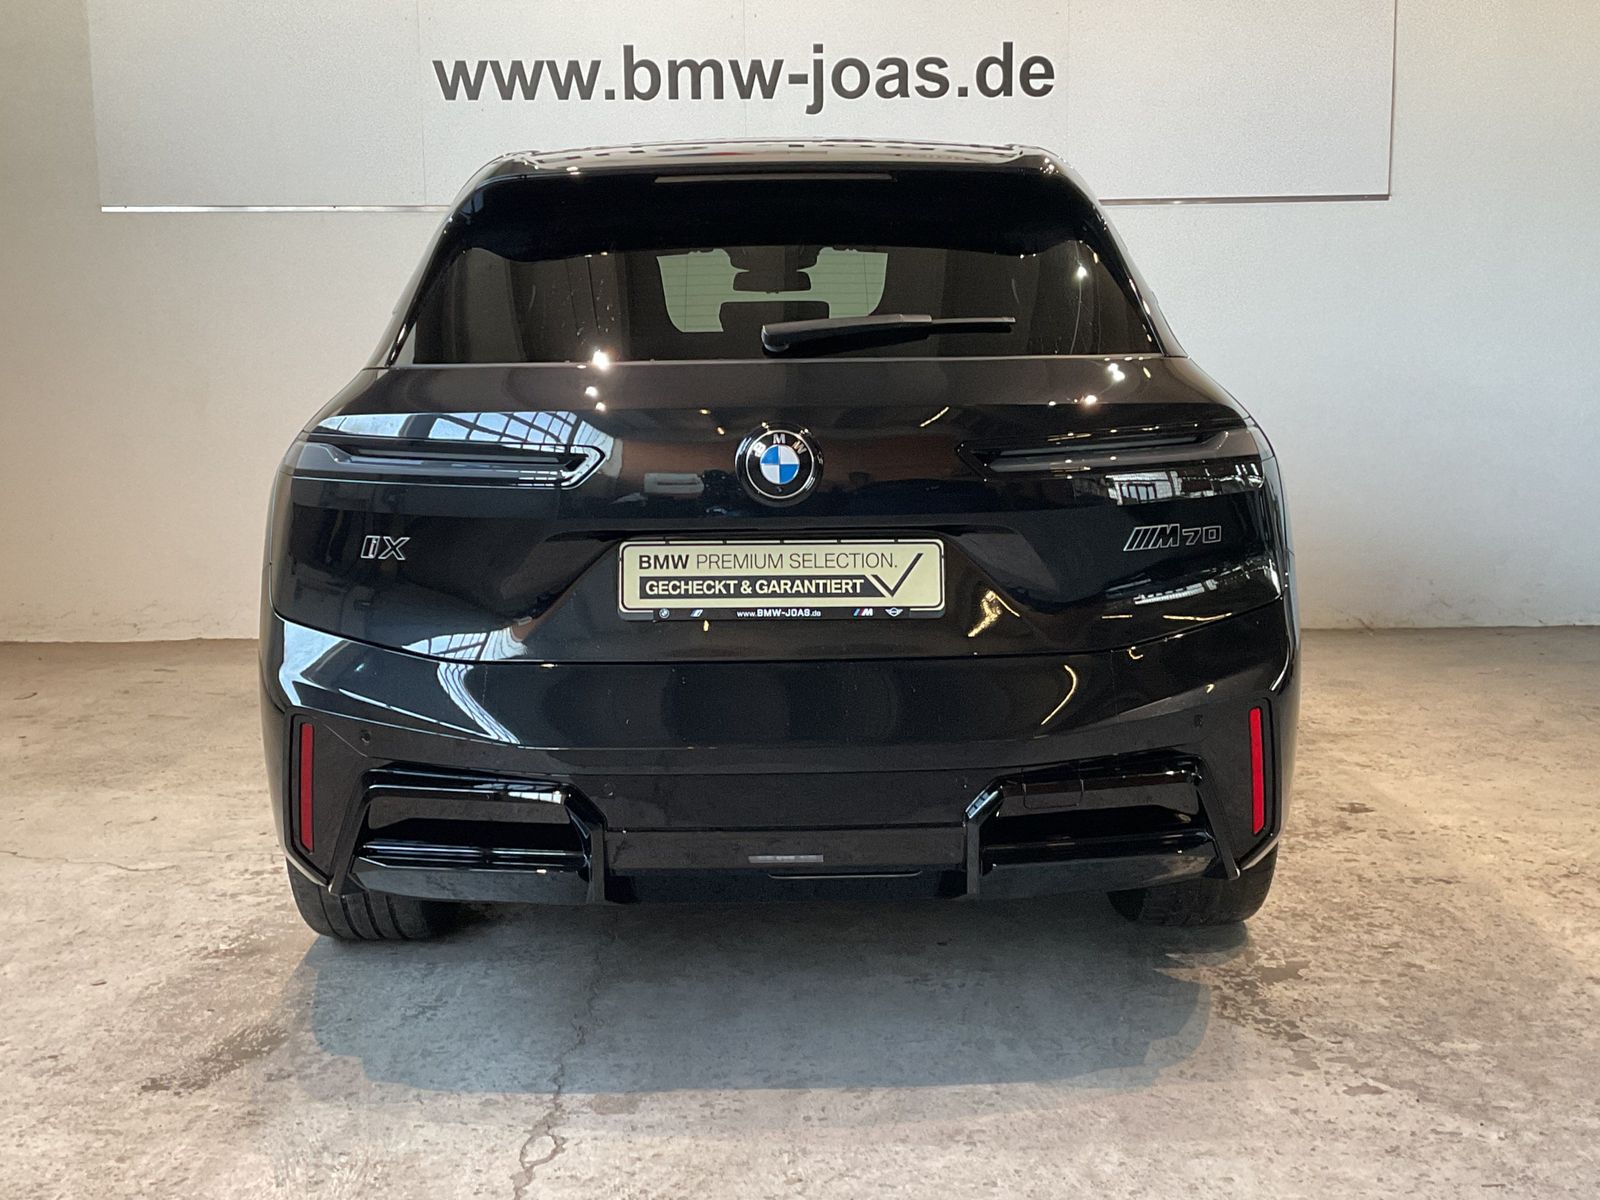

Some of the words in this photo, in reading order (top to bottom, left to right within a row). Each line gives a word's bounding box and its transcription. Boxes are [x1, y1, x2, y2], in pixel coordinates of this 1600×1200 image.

[432, 41, 1056, 115] www.bmw-joas.de
[752, 433, 807, 458] BMW
[639, 554, 690, 570] BMW
[696, 553, 784, 570] PREMIUM
[789, 552, 898, 569] SELECTION.
[645, 580, 738, 595] GECHECKT
[740, 580, 752, 594] &
[755, 579, 864, 594] GARANTIERT
